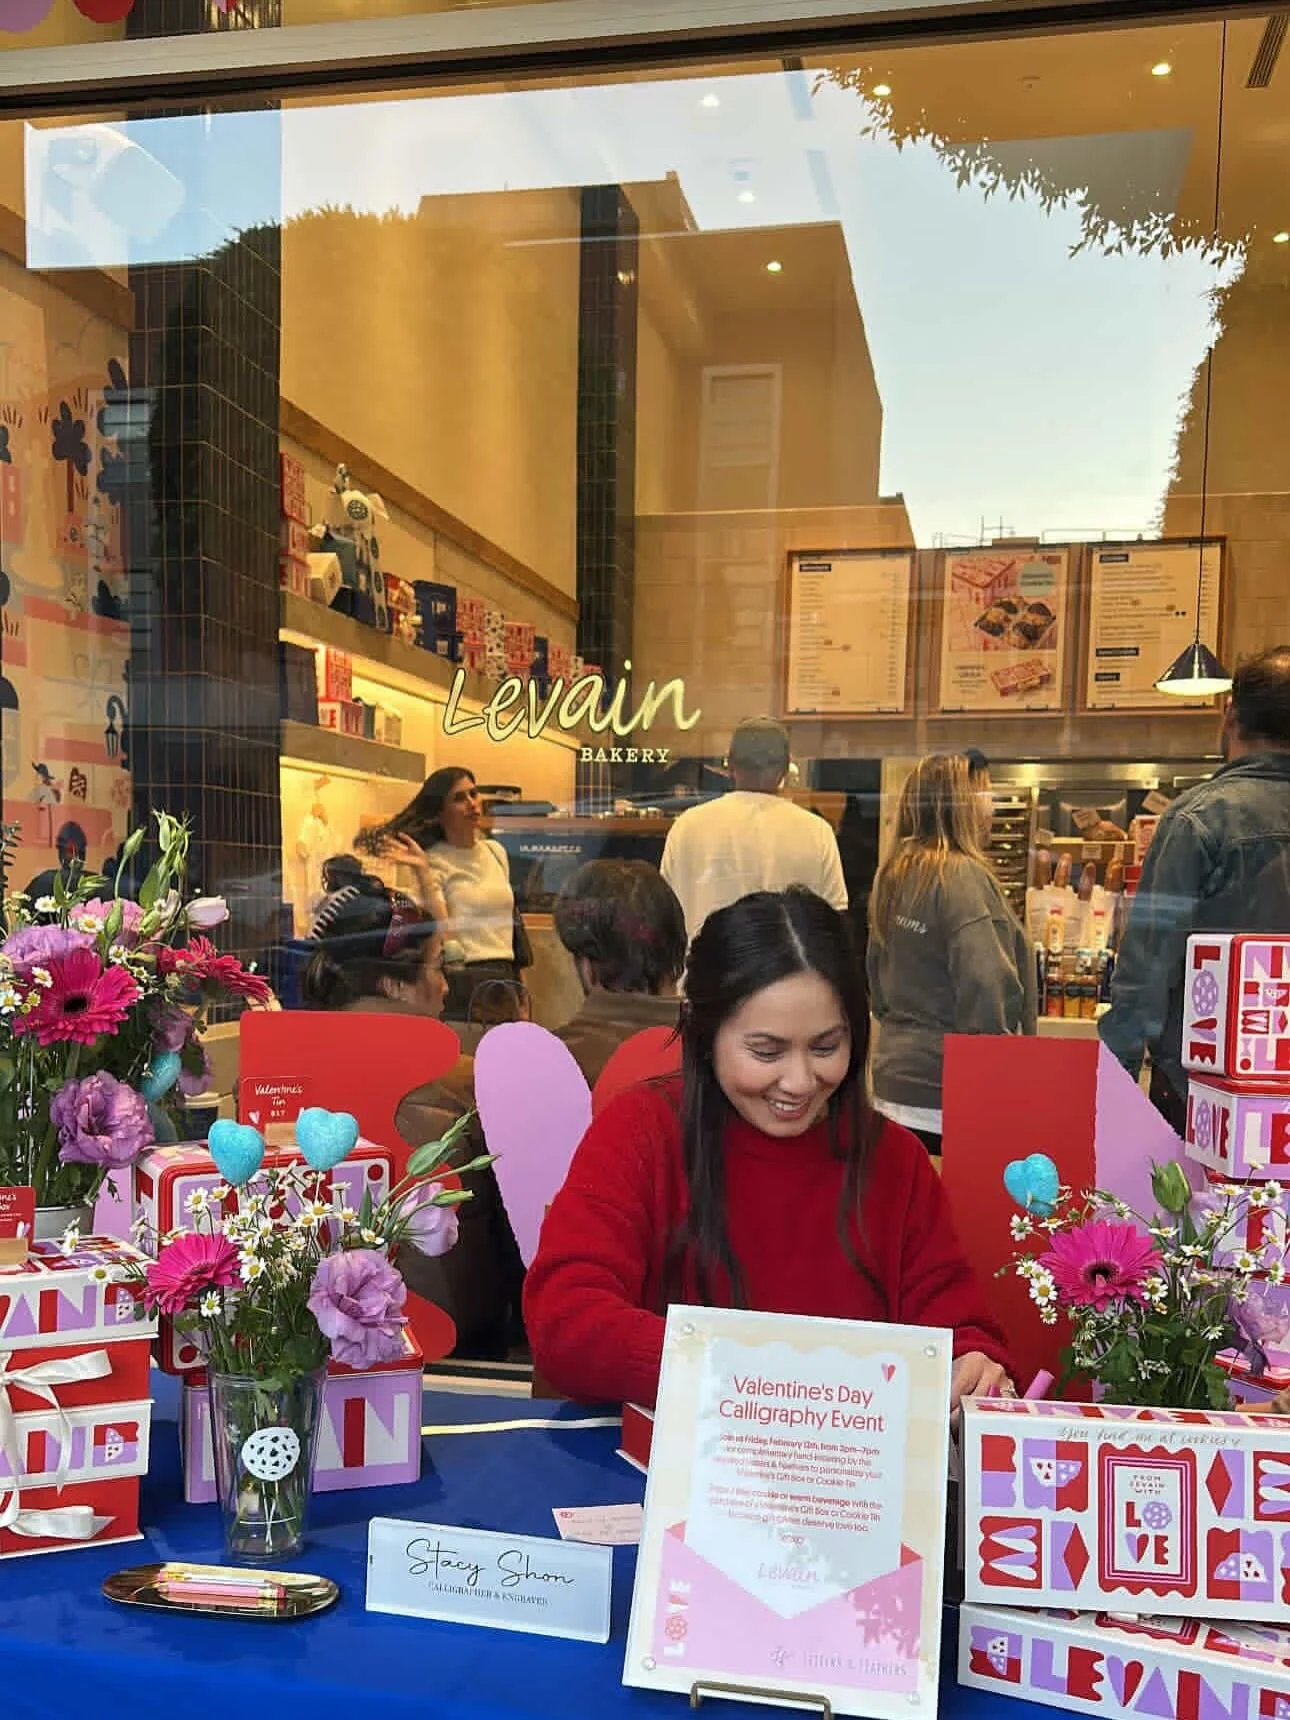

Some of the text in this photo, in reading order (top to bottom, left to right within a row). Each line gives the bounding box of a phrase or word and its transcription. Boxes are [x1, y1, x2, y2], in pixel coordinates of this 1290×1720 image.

[443, 660, 701, 742] Levain
[580, 747, 671, 763] BAKERY
[255, 1082, 304, 1096] Valentine's
[272, 1096, 286, 1106] Tin
[733, 1375, 873, 1410] Valentine's Day
[719, 1399, 885, 1432] Calligraphy Event
[1129, 1481, 1166, 1489] LEVAIN
[406, 1538, 575, 1588] Stacy Shon
[428, 1581, 550, 1607] CALLIGRAPHER & ENGRAVER
[1030, 1637, 1250, 1720] LEVAIN
